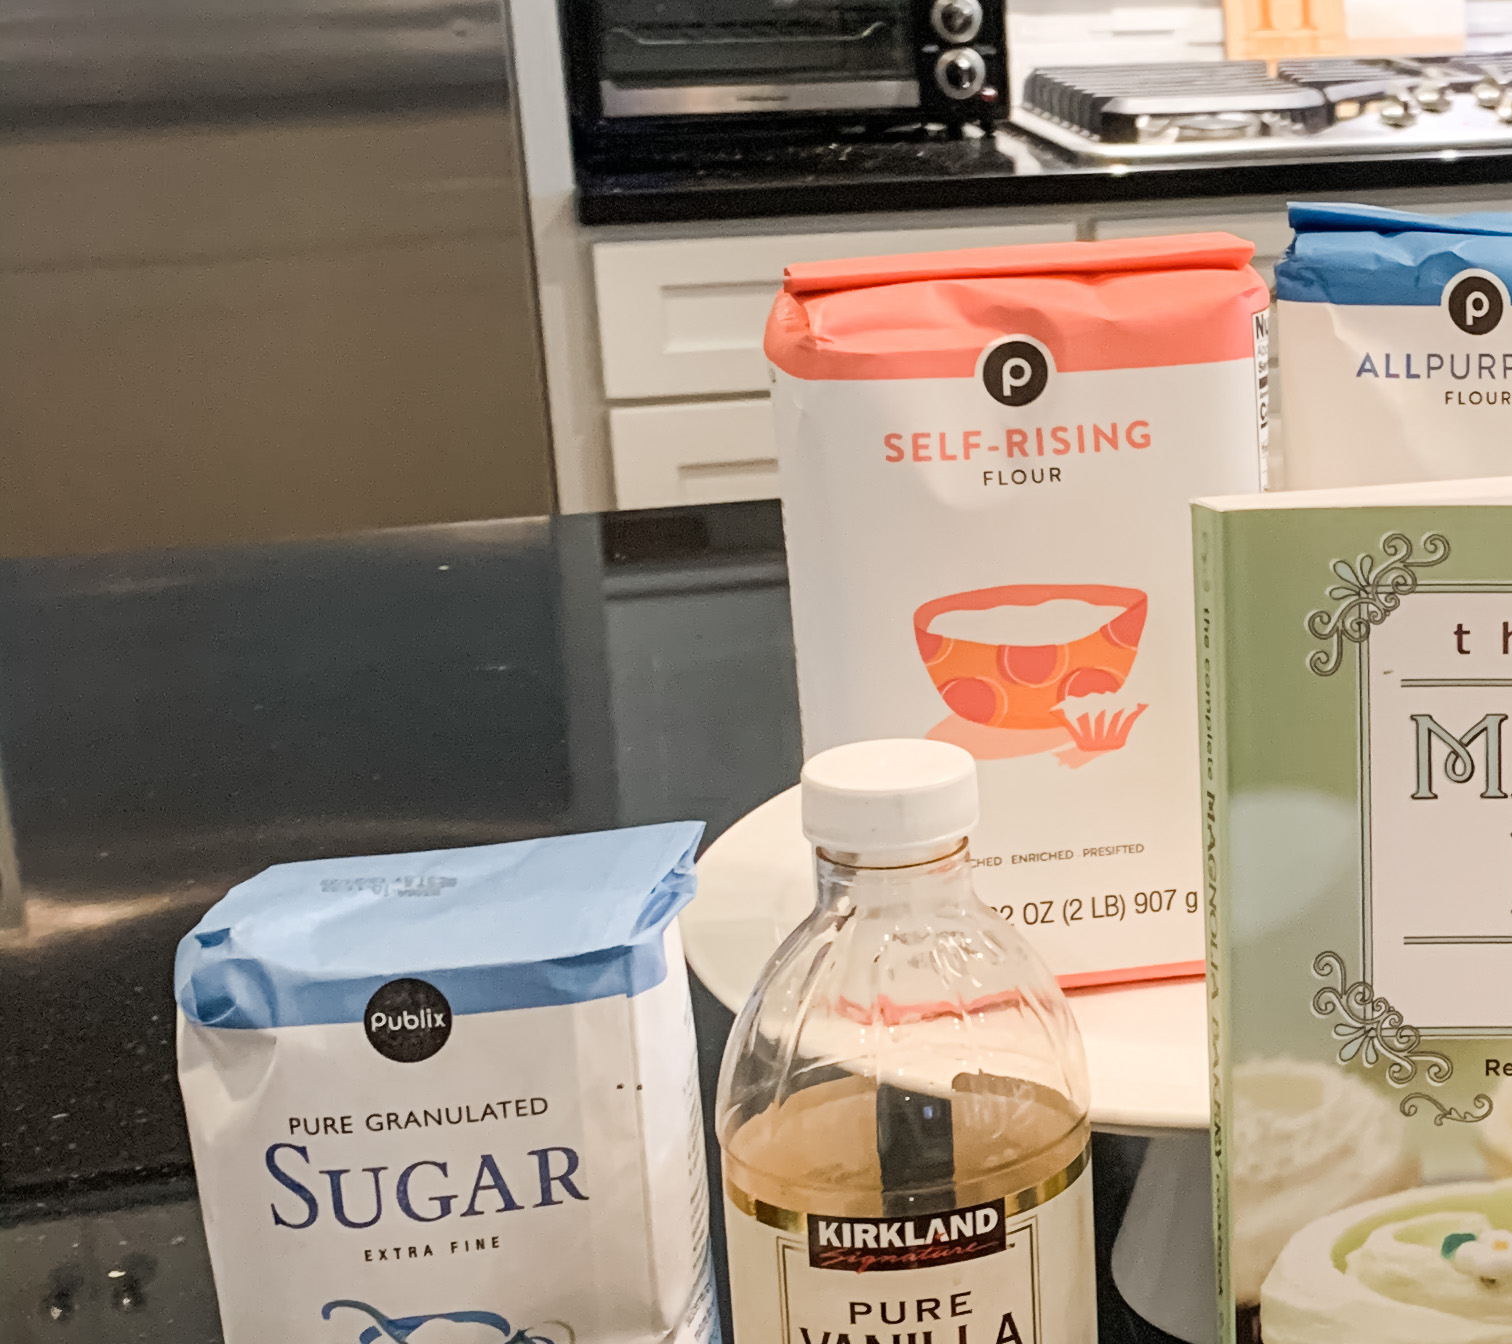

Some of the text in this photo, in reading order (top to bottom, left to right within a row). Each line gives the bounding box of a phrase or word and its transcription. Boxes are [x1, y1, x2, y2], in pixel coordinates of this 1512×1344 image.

[1444, 390, 1512, 406] FLOUR
[883, 419, 1152, 463] SELF-RISING
[982, 467, 1062, 487] FLOUR
[970, 843, 1146, 869] CHED ENRICHED PRESIFTED
[1022, 900, 1056, 926] OZ
[1062, 897, 1084, 927] (2
[1091, 893, 1126, 922] LB)
[1133, 889, 1178, 915] 907
[1185, 890, 1199, 914] g
[371, 1008, 447, 1034] Publix
[288, 1096, 550, 1136] PURE GRANULATED
[265, 1142, 591, 1230] SUGAR
[817, 1207, 999, 1249] KIRKLAND
[363, 1236, 502, 1262] EXTRA FINE
[848, 1290, 974, 1326] PURE
